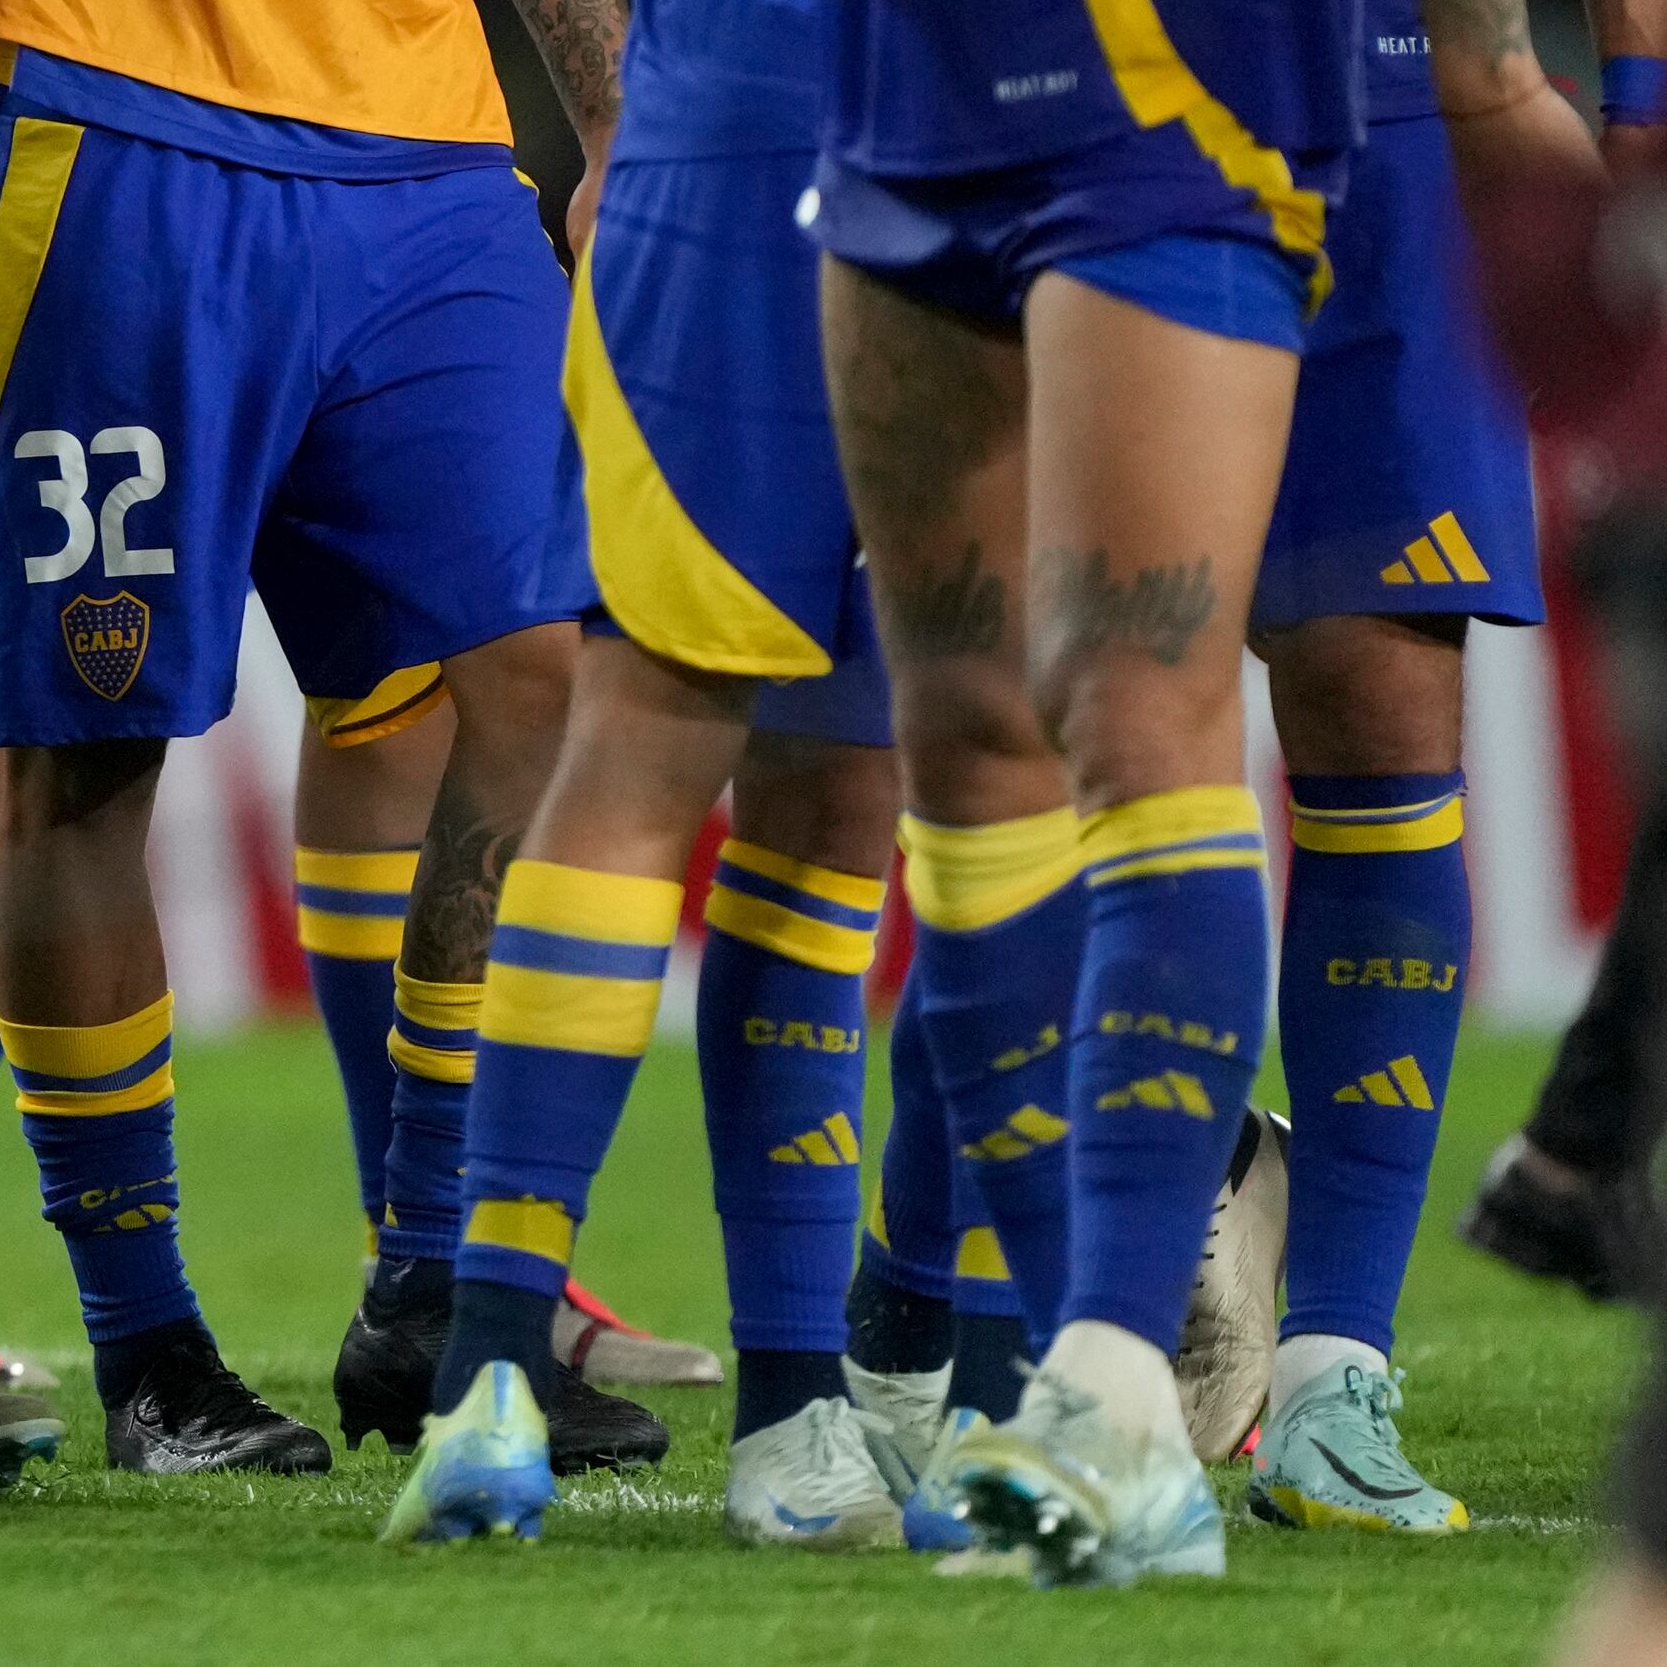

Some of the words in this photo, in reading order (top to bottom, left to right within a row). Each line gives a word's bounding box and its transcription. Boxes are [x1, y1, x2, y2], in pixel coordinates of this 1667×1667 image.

[13, 425, 176, 585] 32
[73, 628, 139, 654] CABJ
[1325, 957, 1459, 993] CABJ
[743, 1016, 860, 1055] CABJ
